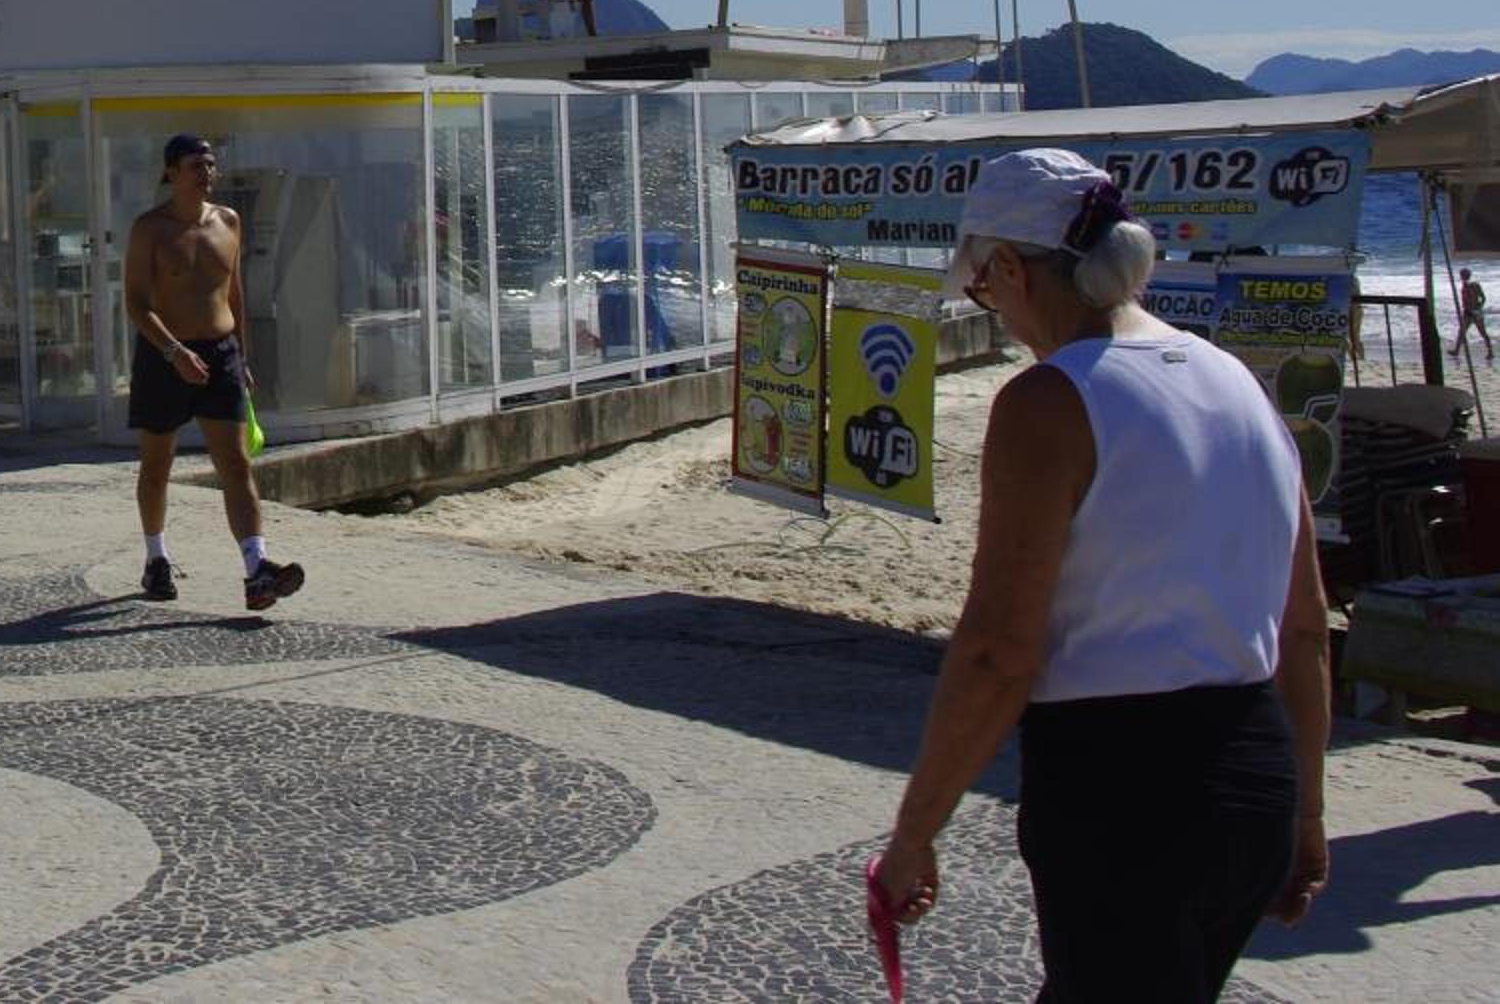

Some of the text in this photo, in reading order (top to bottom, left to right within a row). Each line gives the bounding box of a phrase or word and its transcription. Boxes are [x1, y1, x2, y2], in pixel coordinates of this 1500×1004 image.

[737, 158, 882, 196] Barraca
[891, 153, 937, 195] só
[737, 269, 819, 296] Caipirinha
[1238, 279, 1328, 300] TEMOS
[1268, 307, 1291, 326] de
[1297, 308, 1350, 327] Coco
[739, 371, 816, 400] aipivodka
